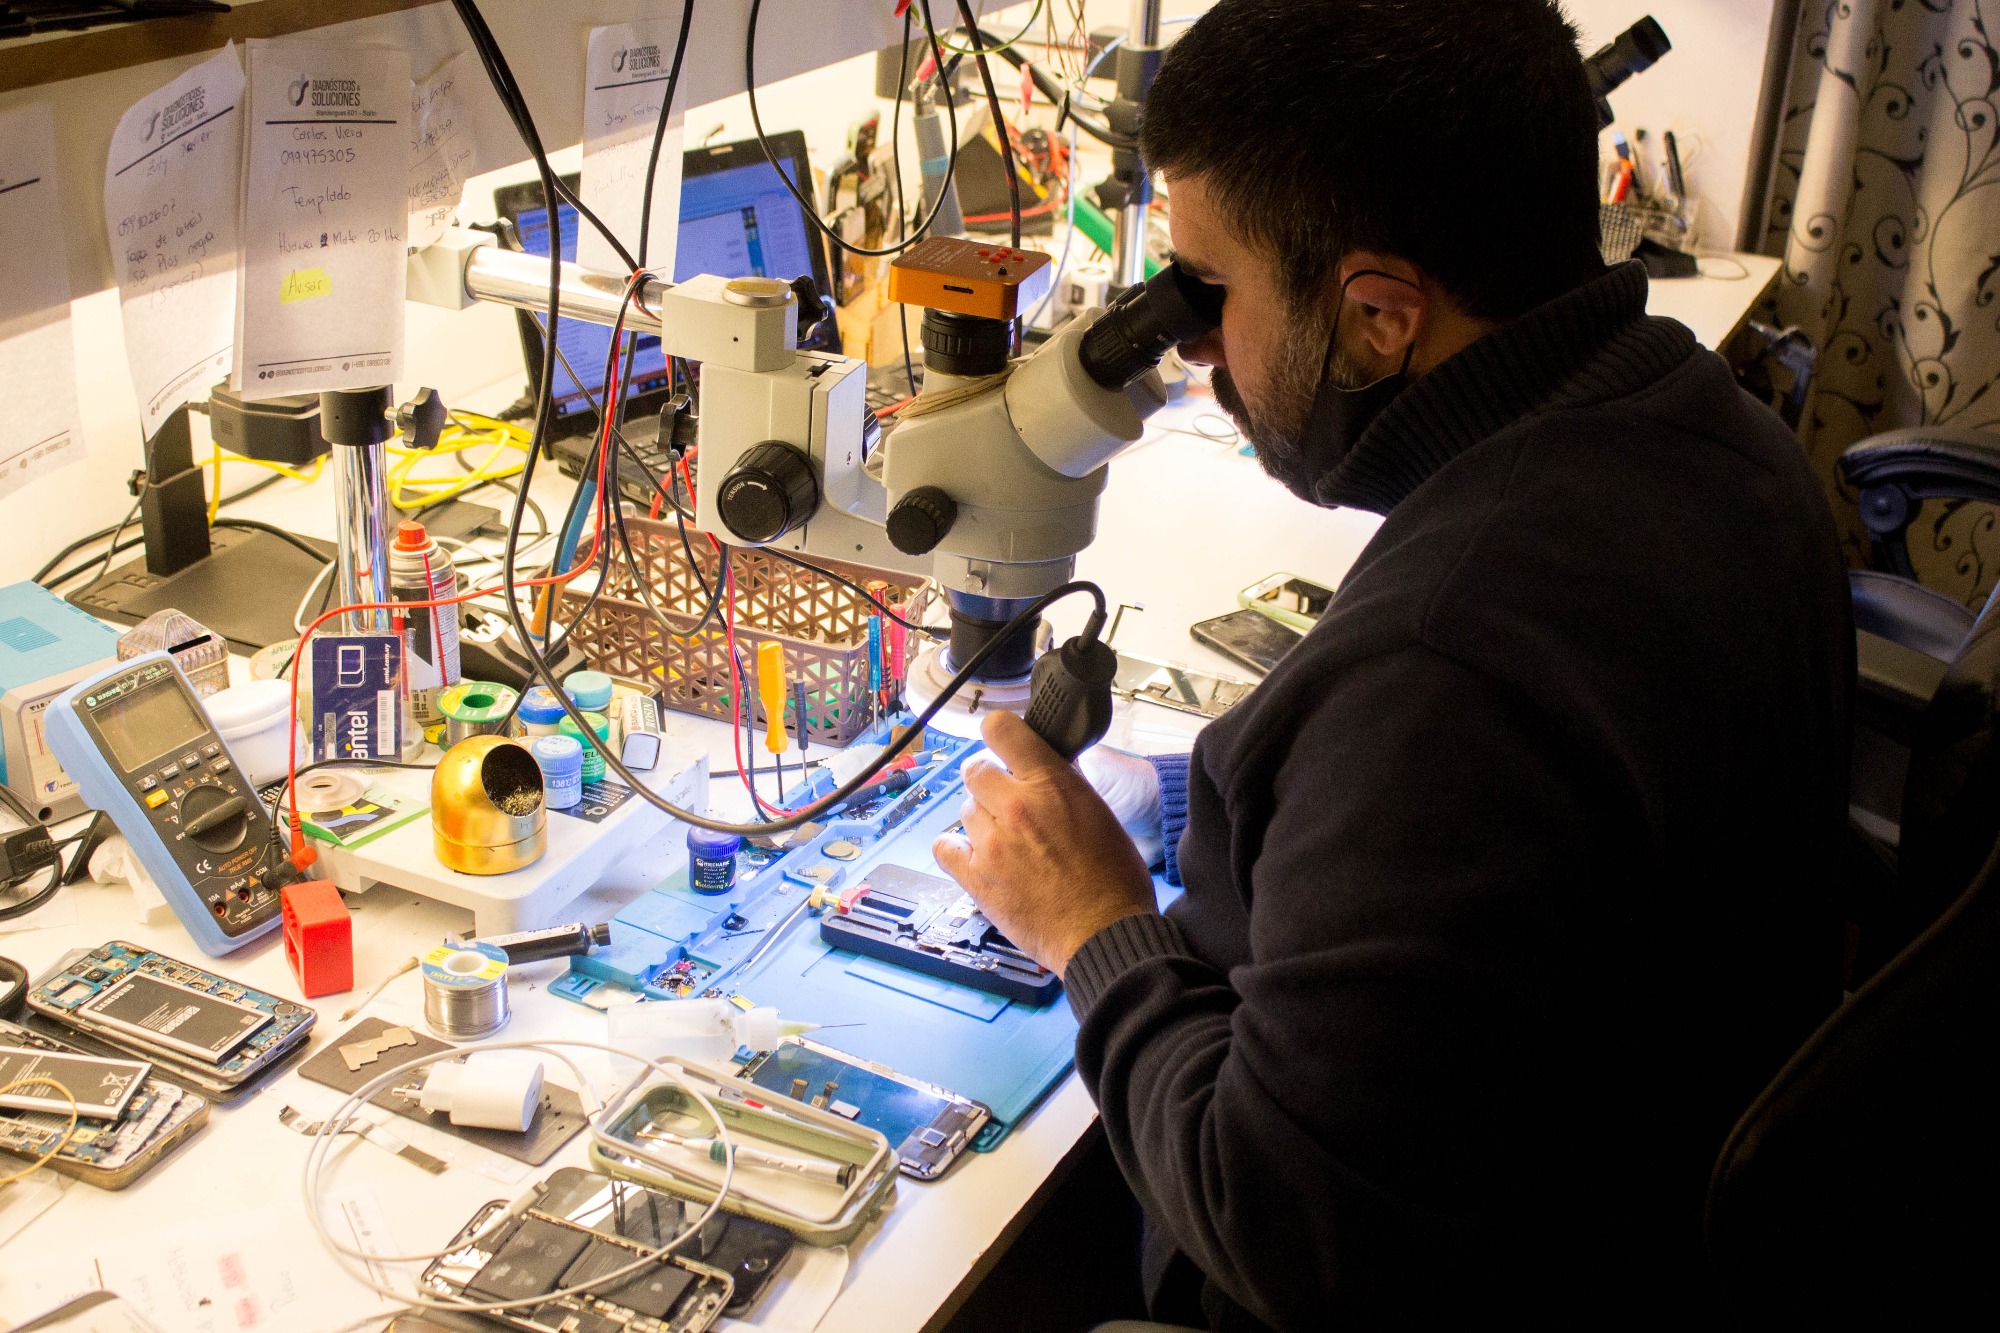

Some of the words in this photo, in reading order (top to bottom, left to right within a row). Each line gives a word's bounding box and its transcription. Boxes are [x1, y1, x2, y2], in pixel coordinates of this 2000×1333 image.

[628, 56, 660, 71] SOLUCIONES
[312, 78, 357, 92] DIAGNÓSTICOS
[311, 92, 361, 107] SOLUCIONES
[162, 95, 205, 132] SOLUCIONES
[292, 127, 327, 141] Carlos
[280, 148, 356, 166] 099475305
[282, 185, 351, 215] Templado
[332, 229, 358, 246] Mate
[727, 481, 746, 501] TENSION
[383, 643, 391, 684] antel.com.uy
[643, 702, 657, 728] ROSIN
[347, 711, 368, 759] antel
[144, 779, 156, 789] HOLD
[175, 831, 186, 841] OFF
[196, 859, 212, 874] CE
[218, 861, 232, 873] AUTO
[231, 852, 249, 865] POWER
[248, 846, 258, 857] OFF
[229, 864, 243, 874] TRUE
[255, 866, 268, 877] COM
[208, 893, 221, 903] 10A
[430, 970, 456, 982] SANKI
[94, 983, 135, 1012] SAMSUNG
